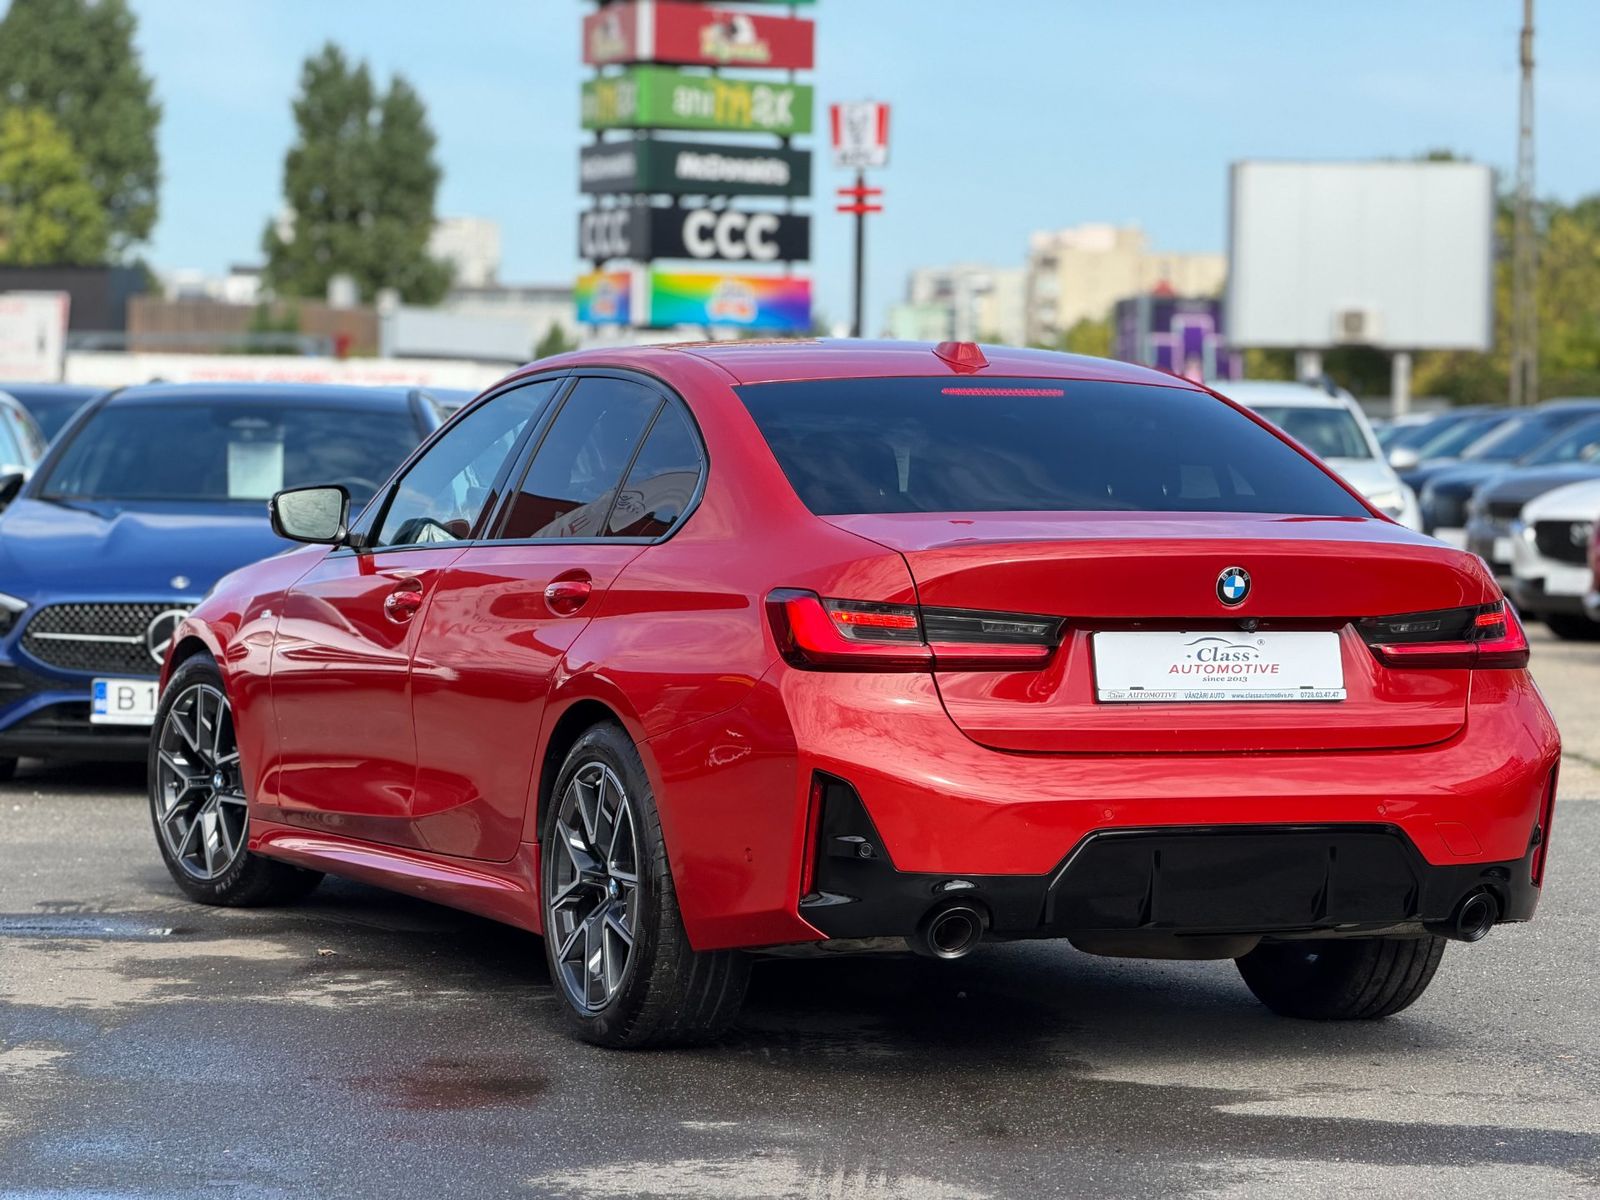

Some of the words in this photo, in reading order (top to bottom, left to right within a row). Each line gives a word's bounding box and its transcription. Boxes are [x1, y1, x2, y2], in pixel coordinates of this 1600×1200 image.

[683, 208, 780, 260] CCC
[1220, 568, 1249, 581] BMW
[1196, 646, 1251, 663] Class
[1168, 663, 1280, 675] AUTOMOTIVE
[117, 686, 135, 710] B
[1128, 691, 1177, 699] AUTOMOTIVE
